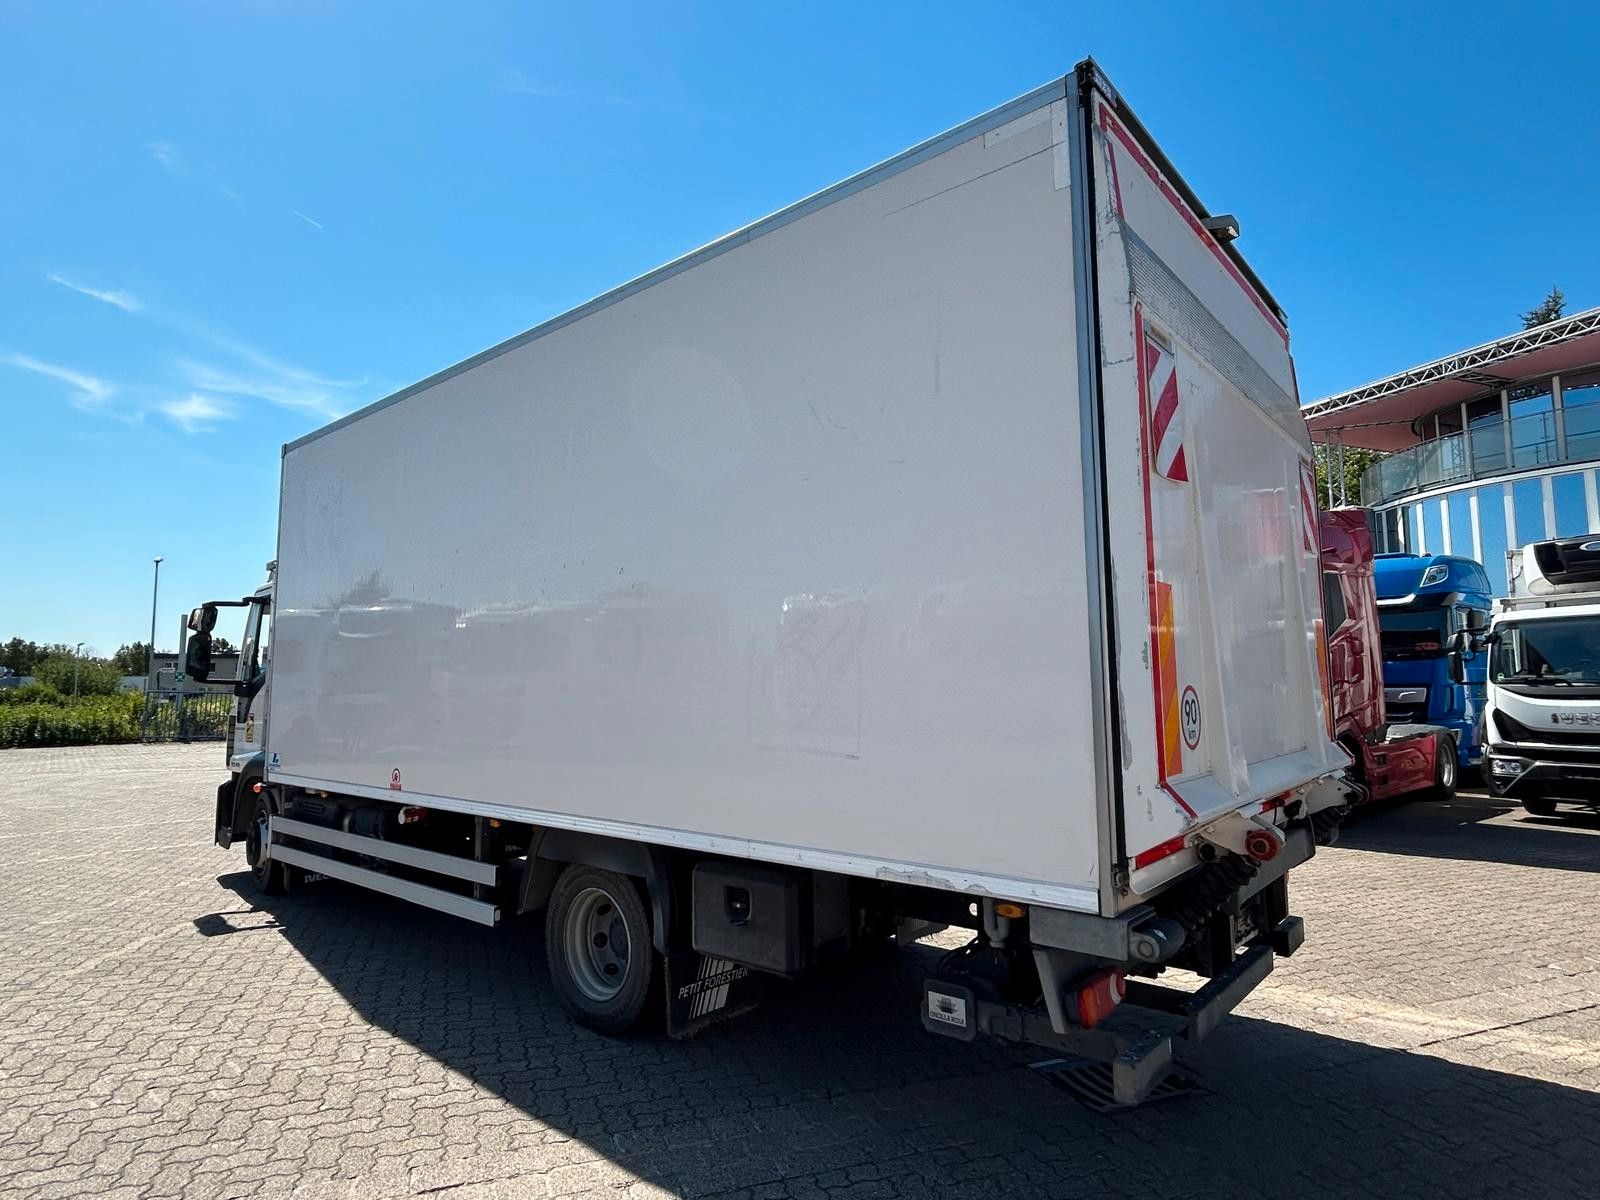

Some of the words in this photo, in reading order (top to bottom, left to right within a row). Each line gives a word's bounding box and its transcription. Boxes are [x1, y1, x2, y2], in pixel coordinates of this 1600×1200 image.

[1184, 698, 1197, 726] 90
[1188, 727, 1197, 740] km
[678, 980, 703, 1000] PETIT
[703, 967, 752, 990] FORESTIER
